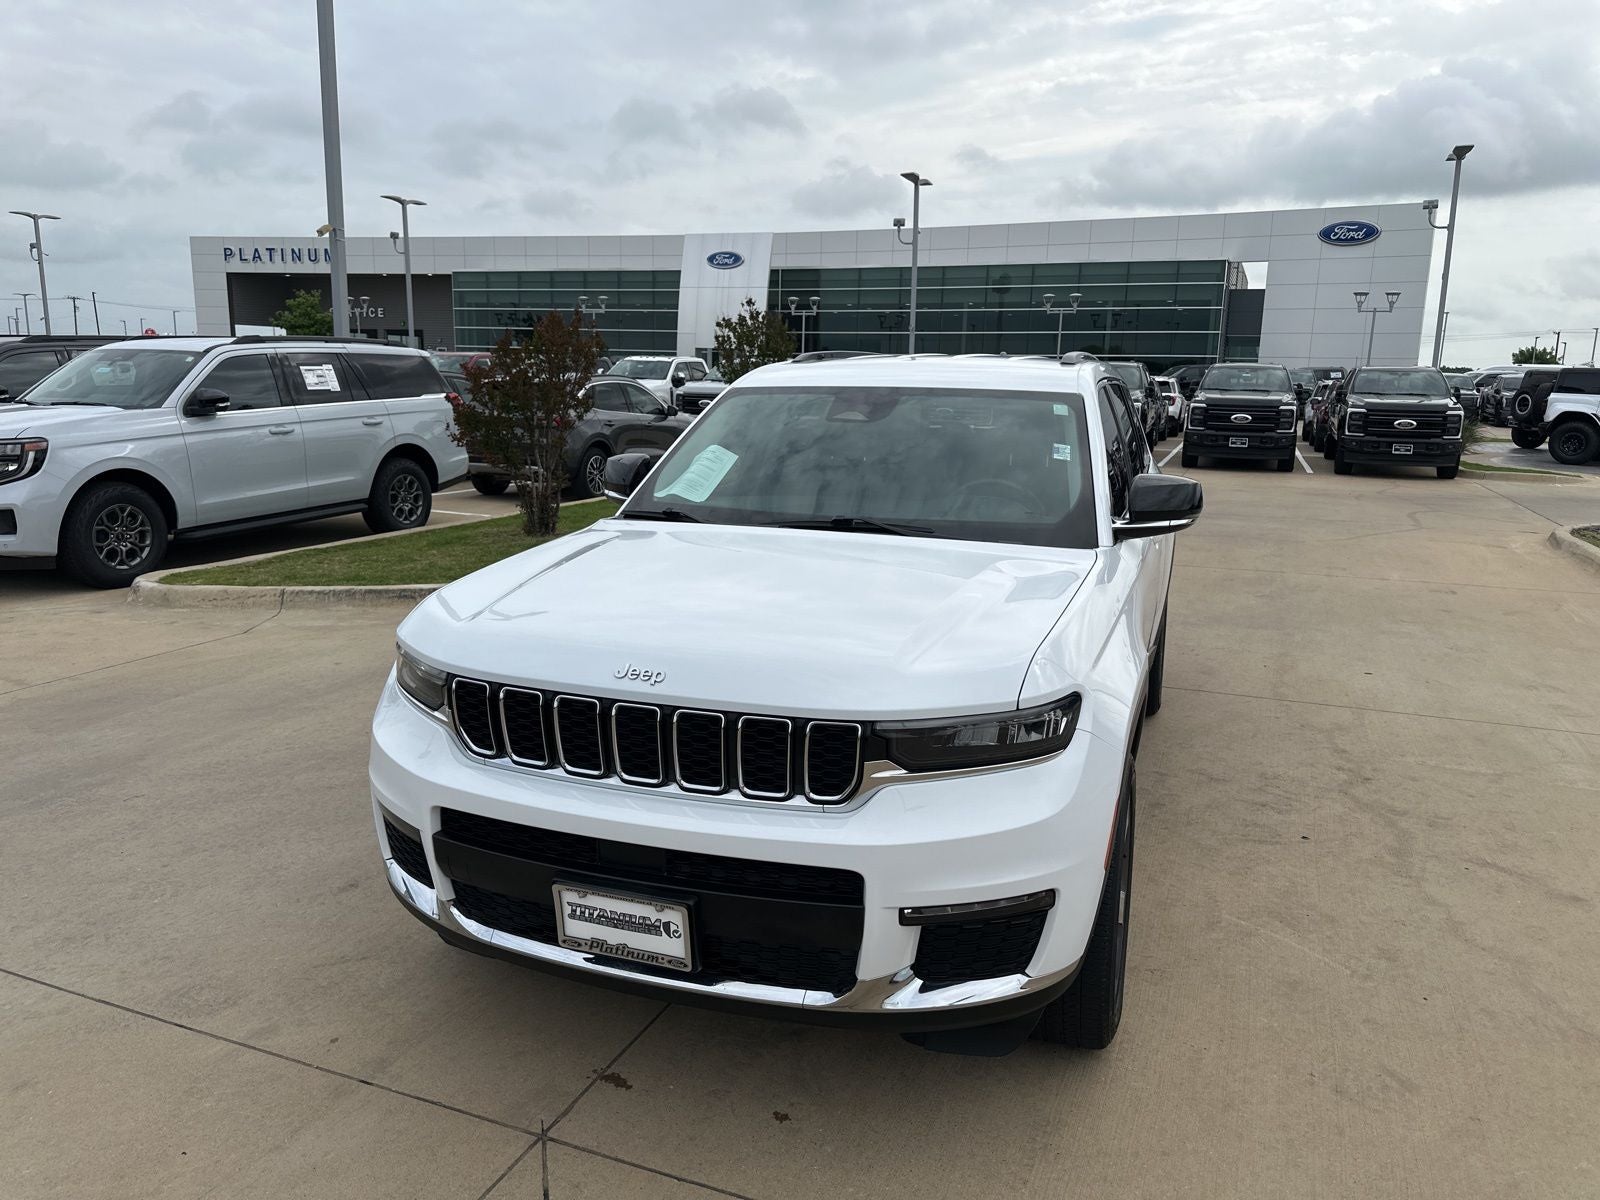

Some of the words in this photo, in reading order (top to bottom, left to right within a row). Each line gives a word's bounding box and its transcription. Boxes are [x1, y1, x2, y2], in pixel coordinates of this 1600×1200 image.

[1330, 225, 1366, 240] Ford
[713, 254, 734, 265] Ford
[614, 663, 667, 687] Jeep
[566, 901, 662, 930] TITANIUM
